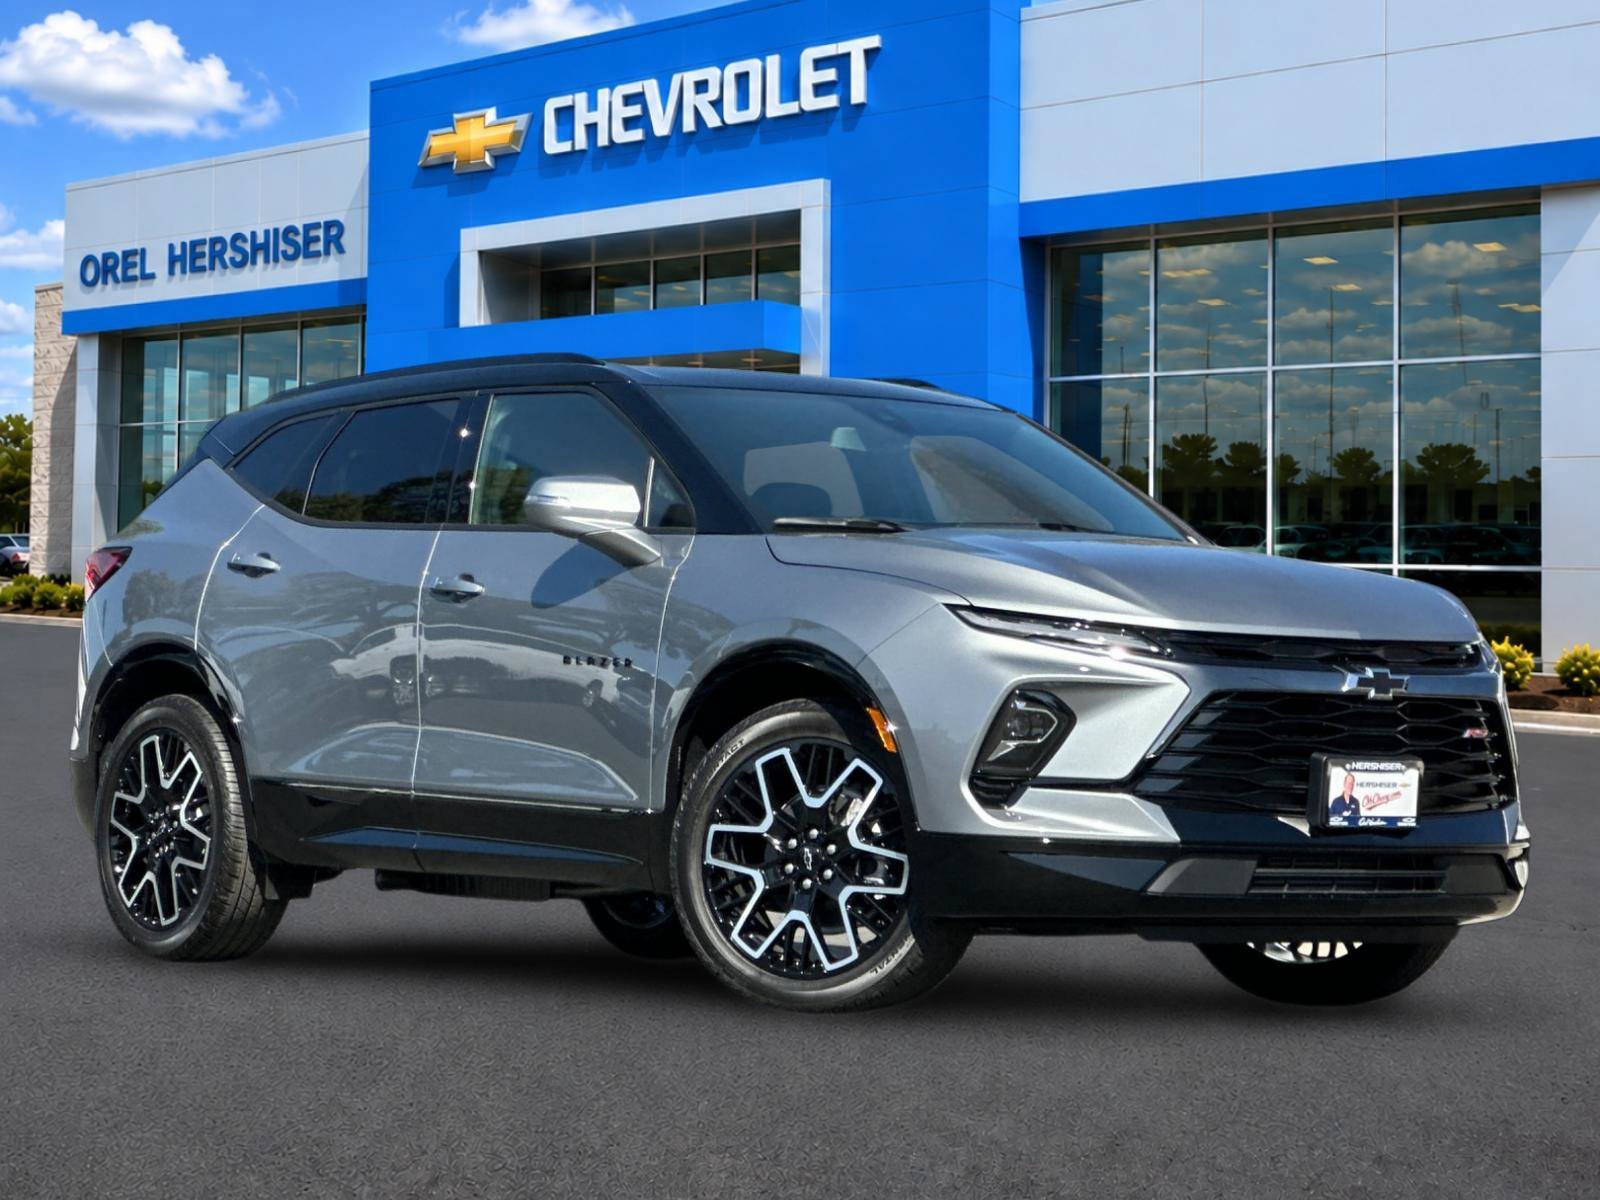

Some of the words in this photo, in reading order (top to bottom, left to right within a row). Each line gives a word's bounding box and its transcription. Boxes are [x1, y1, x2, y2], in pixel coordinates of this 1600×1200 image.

[544, 34, 882, 155] CHEVROLET
[79, 247, 156, 288] OREL
[168, 219, 346, 276] HERSHISER
[563, 655, 632, 668] BLAZER
[1352, 761, 1402, 771] HERSHISER
